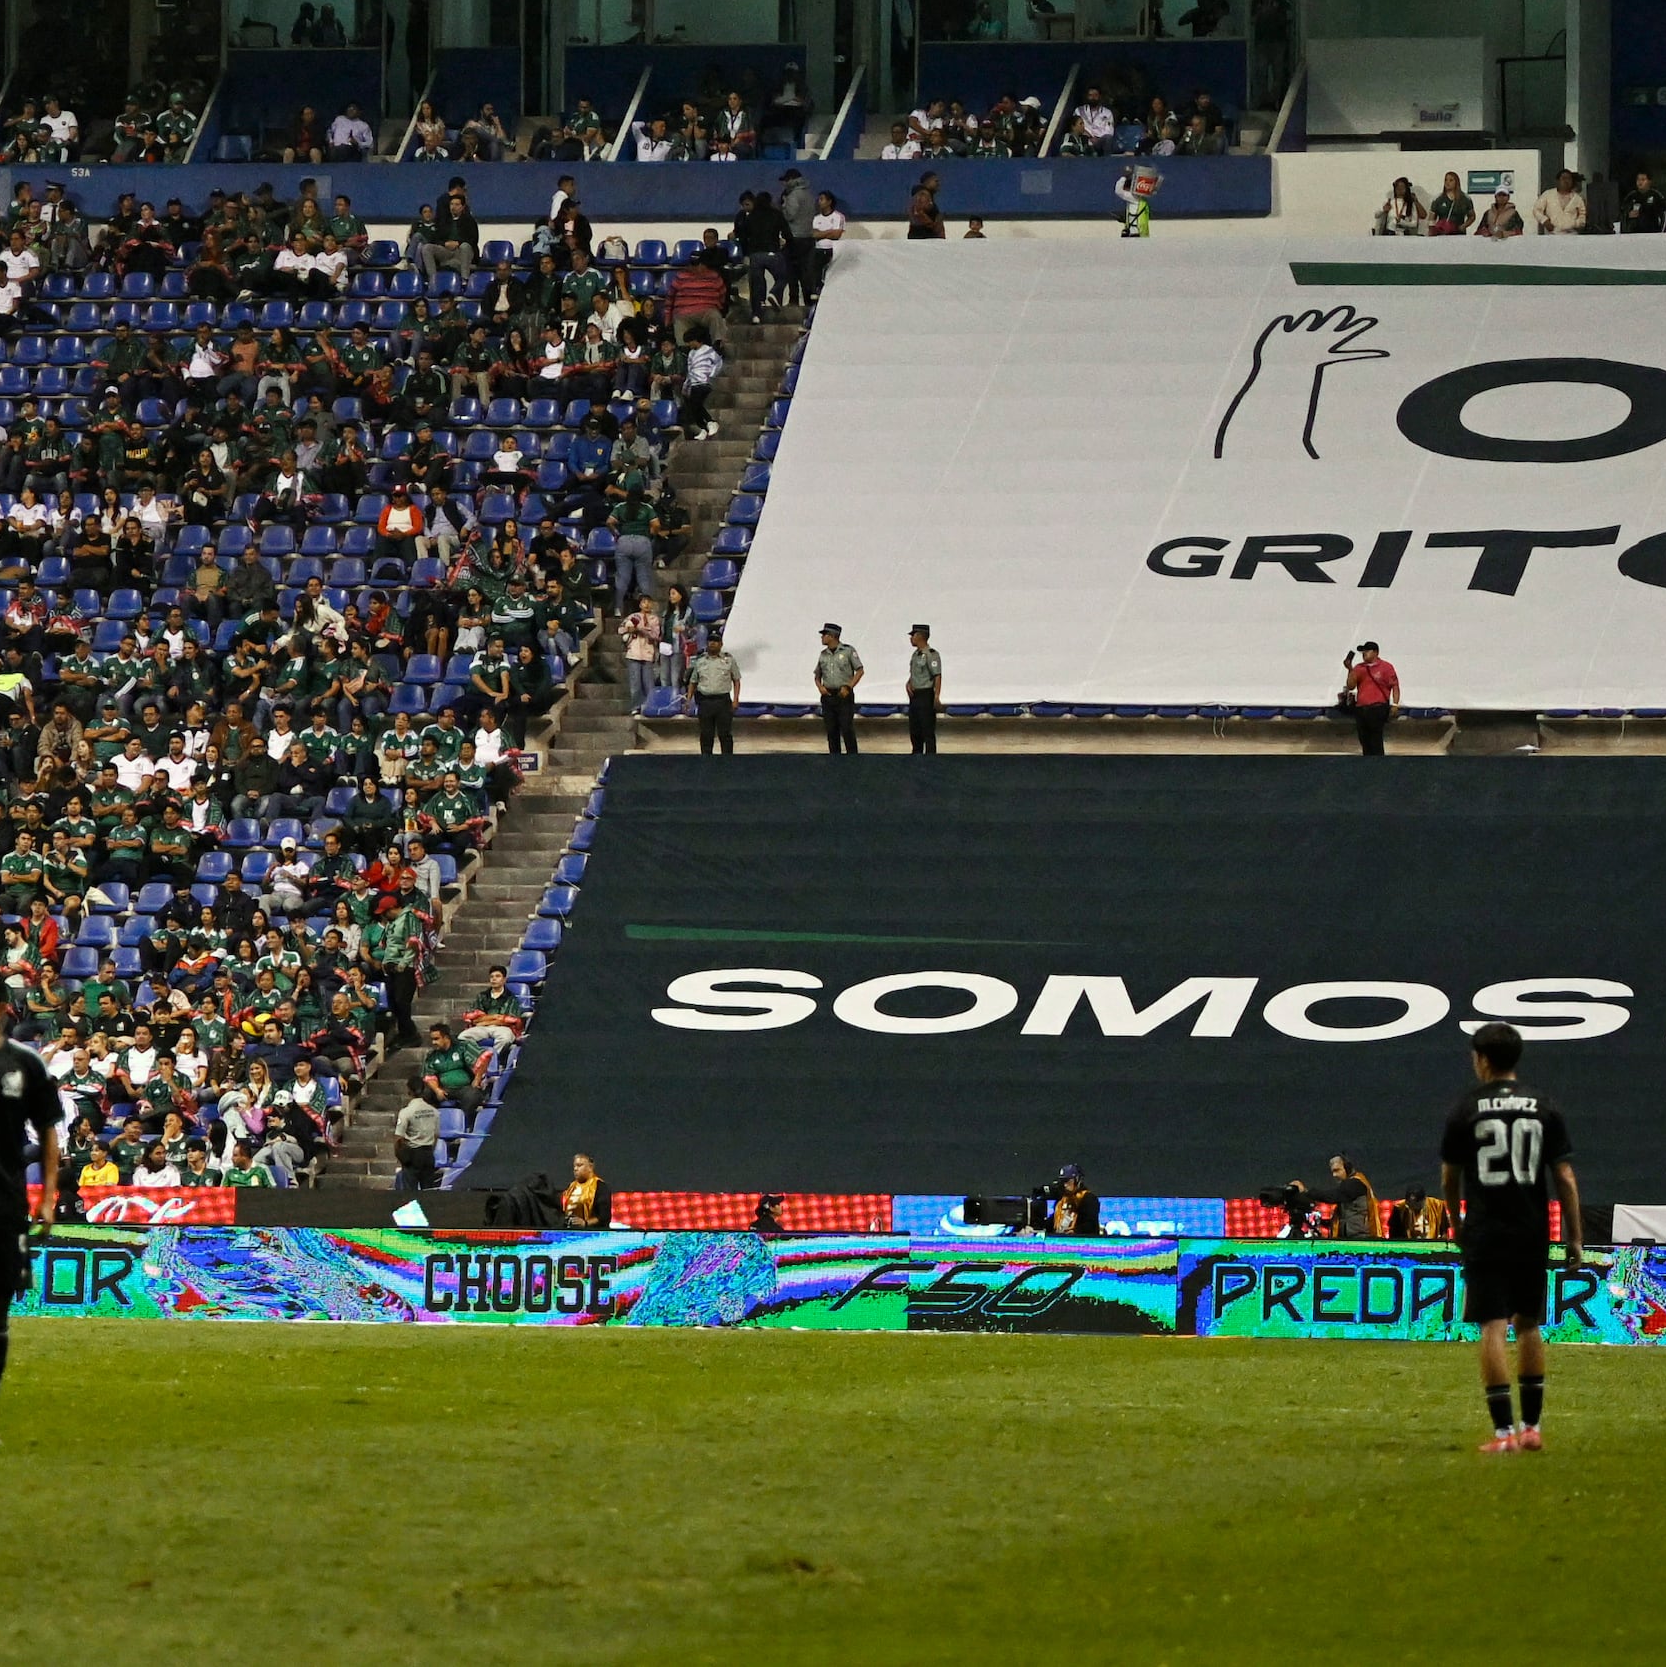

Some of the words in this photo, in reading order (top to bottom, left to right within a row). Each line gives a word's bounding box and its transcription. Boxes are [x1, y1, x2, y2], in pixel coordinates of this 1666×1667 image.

[650, 967, 1636, 1043] SOMOS
[1474, 1117, 1544, 1187] 20
[424, 1252, 618, 1313] CHOOSE
[1212, 1264, 1600, 1330] PREDAR
